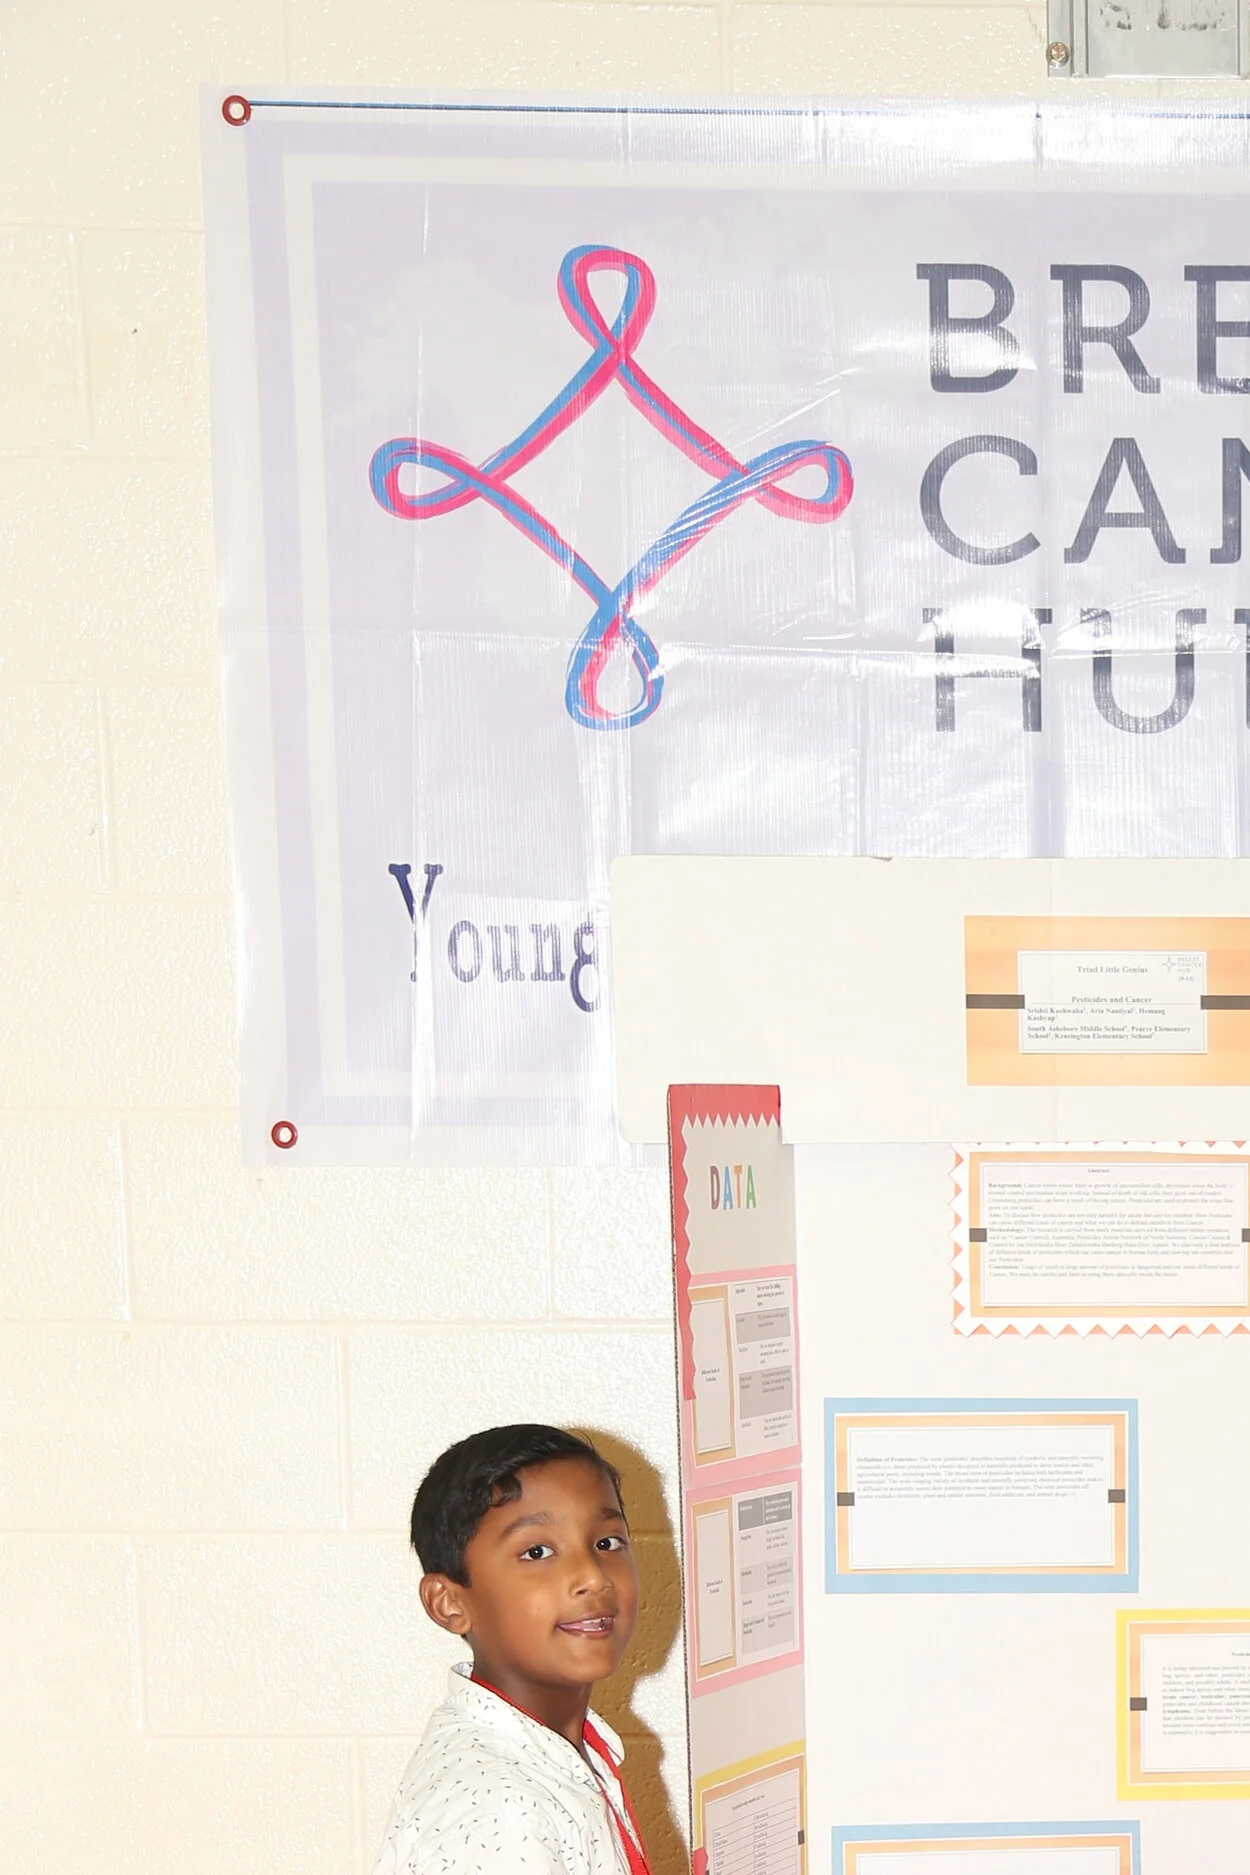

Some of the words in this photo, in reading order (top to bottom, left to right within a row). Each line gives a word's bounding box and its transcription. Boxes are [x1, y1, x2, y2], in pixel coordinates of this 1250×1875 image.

[388, 863, 601, 1013] Young
[1077, 965, 1098, 974] Triad
[1100, 965, 1120, 974] Little
[1122, 965, 1148, 974] Genius
[709, 1164, 757, 1211] DATA
